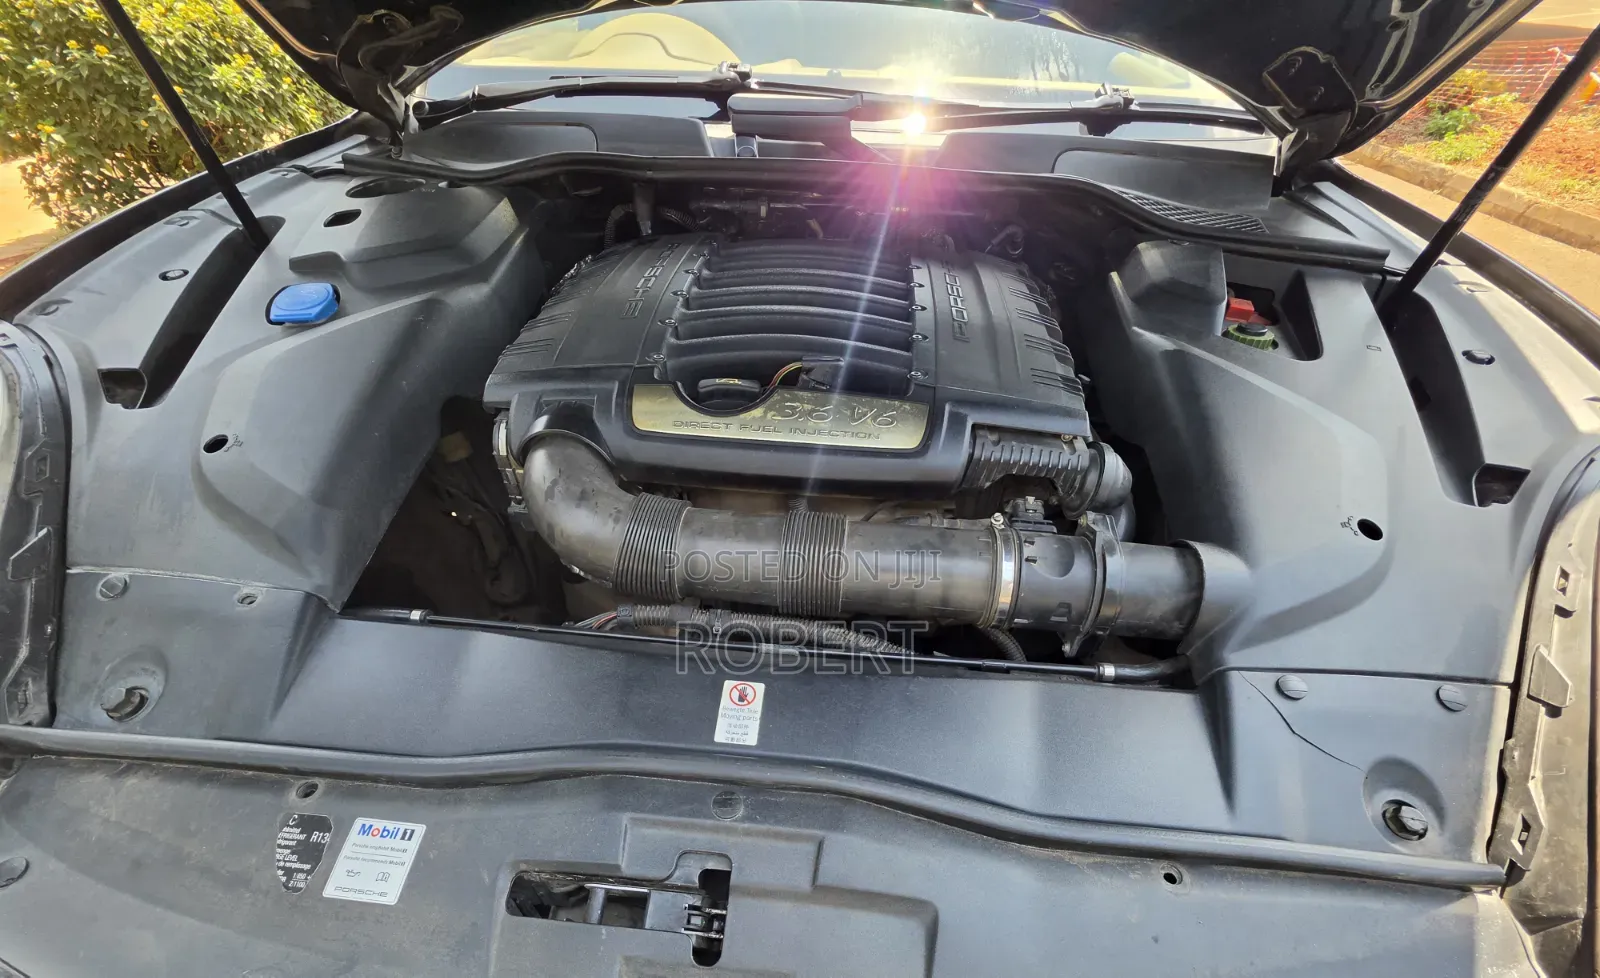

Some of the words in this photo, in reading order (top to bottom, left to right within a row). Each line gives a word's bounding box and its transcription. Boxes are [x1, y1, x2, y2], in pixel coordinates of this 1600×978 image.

[771, 402, 834, 423] 3.6
[851, 405, 897, 428] V6
[672, 420, 733, 431] DIRECT
[739, 424, 783, 435] FUEL
[788, 427, 881, 441] INJECTION
[357, 824, 401, 840] Mobil
[403, 829, 414, 841] 1
[334, 886, 389, 897] PORSCHE
